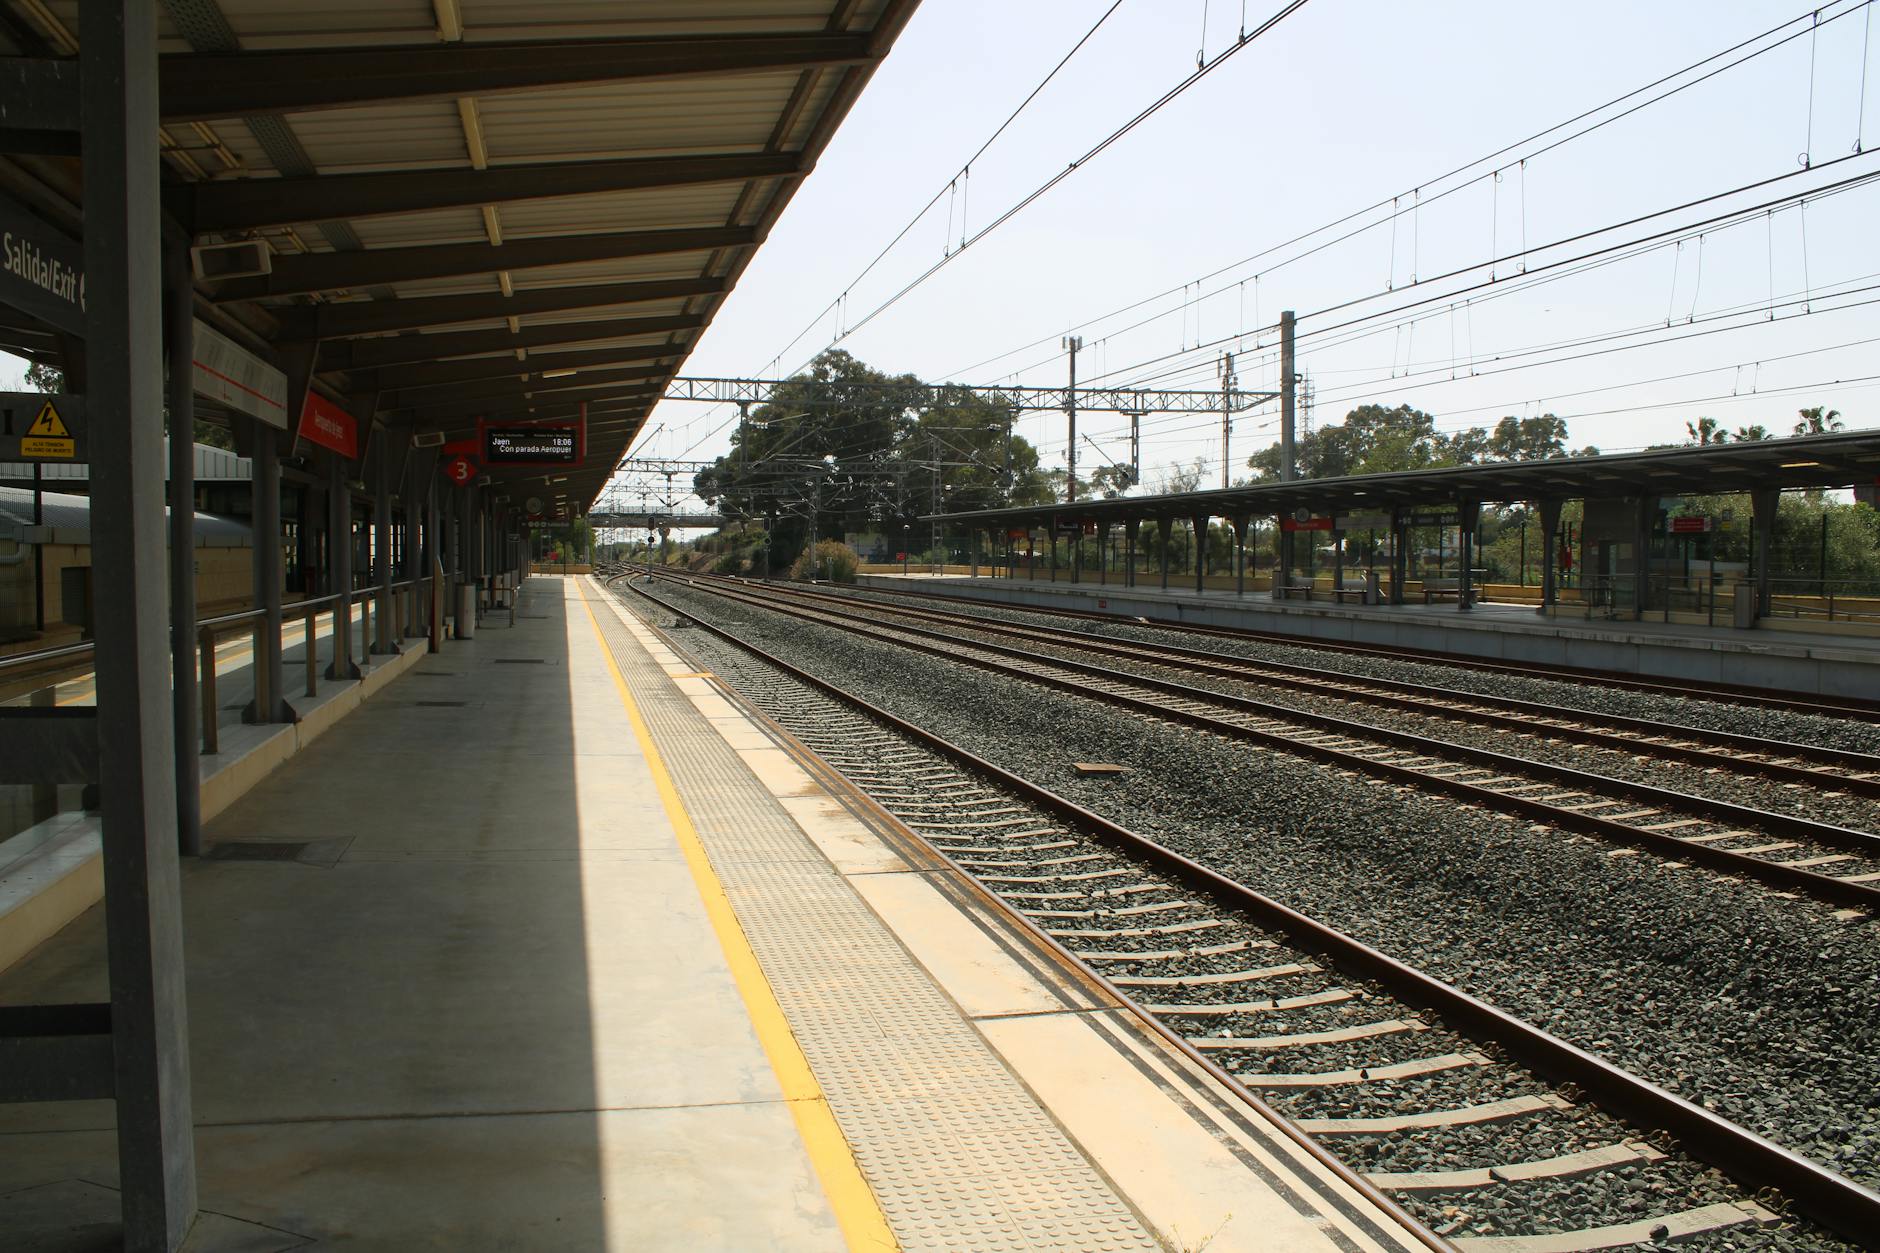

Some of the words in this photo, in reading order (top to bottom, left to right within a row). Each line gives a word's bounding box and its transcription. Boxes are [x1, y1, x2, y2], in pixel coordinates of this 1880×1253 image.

[4, 232, 76, 304] Salida/Exit
[499, 445, 514, 453] Con
[515, 445, 539, 454] parada
[456, 462, 468, 480] 3
